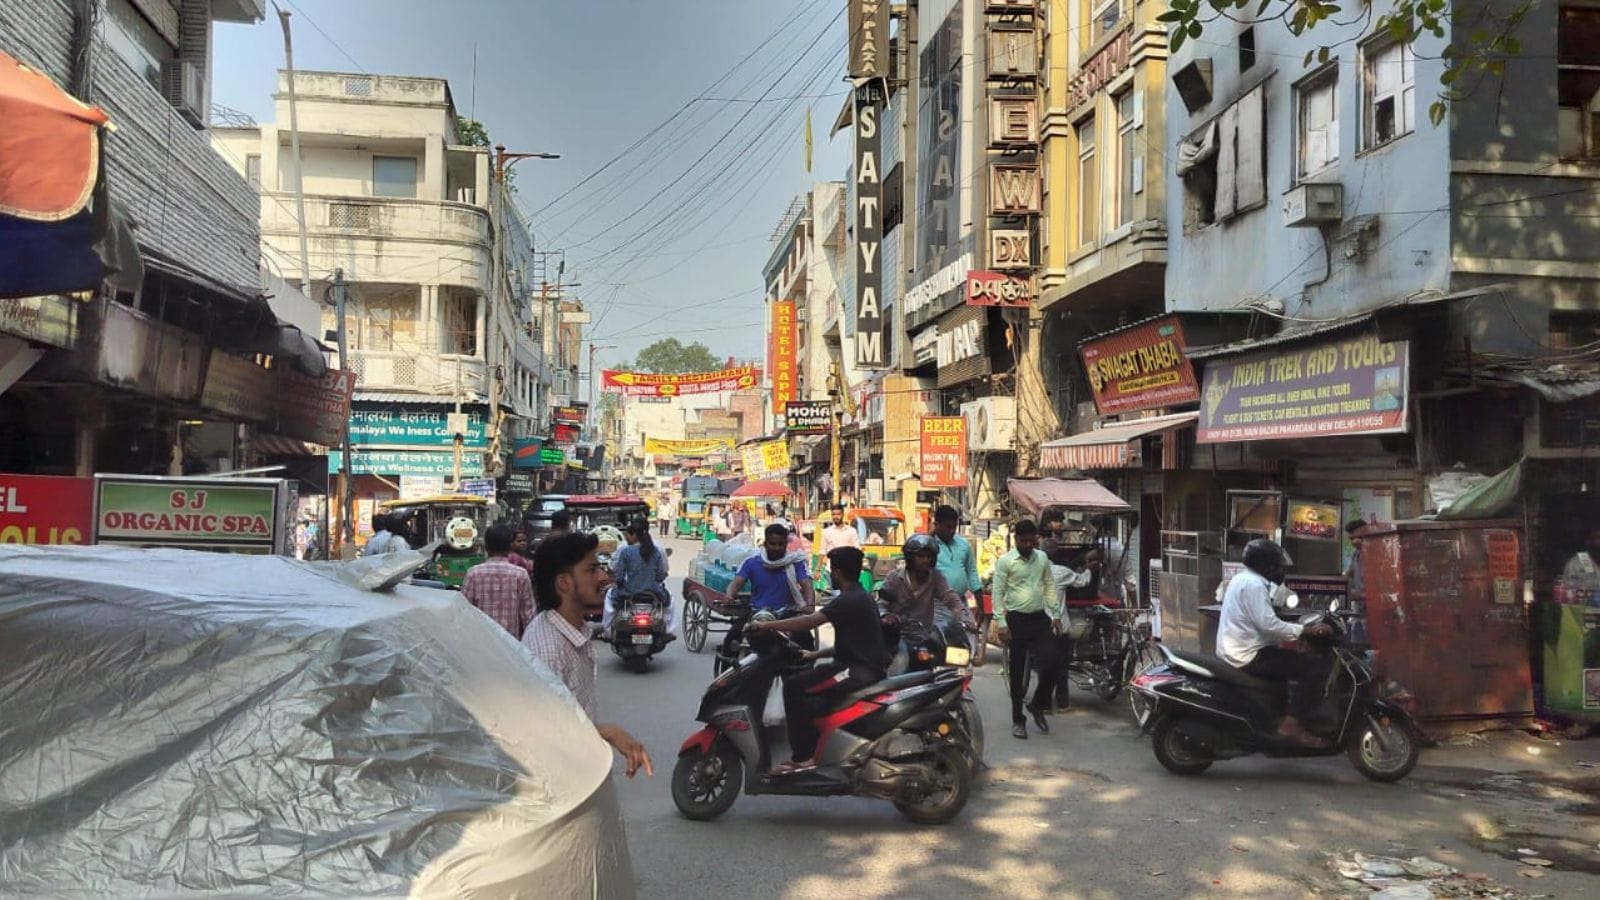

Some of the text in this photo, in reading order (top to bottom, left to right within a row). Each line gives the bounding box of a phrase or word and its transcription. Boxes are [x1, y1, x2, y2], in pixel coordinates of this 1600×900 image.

[861, 0, 877, 72] N PLAZA
[858, 104, 881, 363] SATYAM
[778, 305, 790, 356] HOTEL
[1098, 350, 1140, 382] SWAGAT
[1139, 339, 1180, 374] DHABA
[1232, 338, 1396, 388] INDIA TREK AND TOURS
[349, 424, 480, 439] malaya Welness Coany
[923, 418, 963, 432] BEER
[930, 435, 960, 446] FREE
[436, 464, 484, 475] Copany
[0, 487, 28, 512] L
[104, 511, 269, 534] ORGANIC SPA
